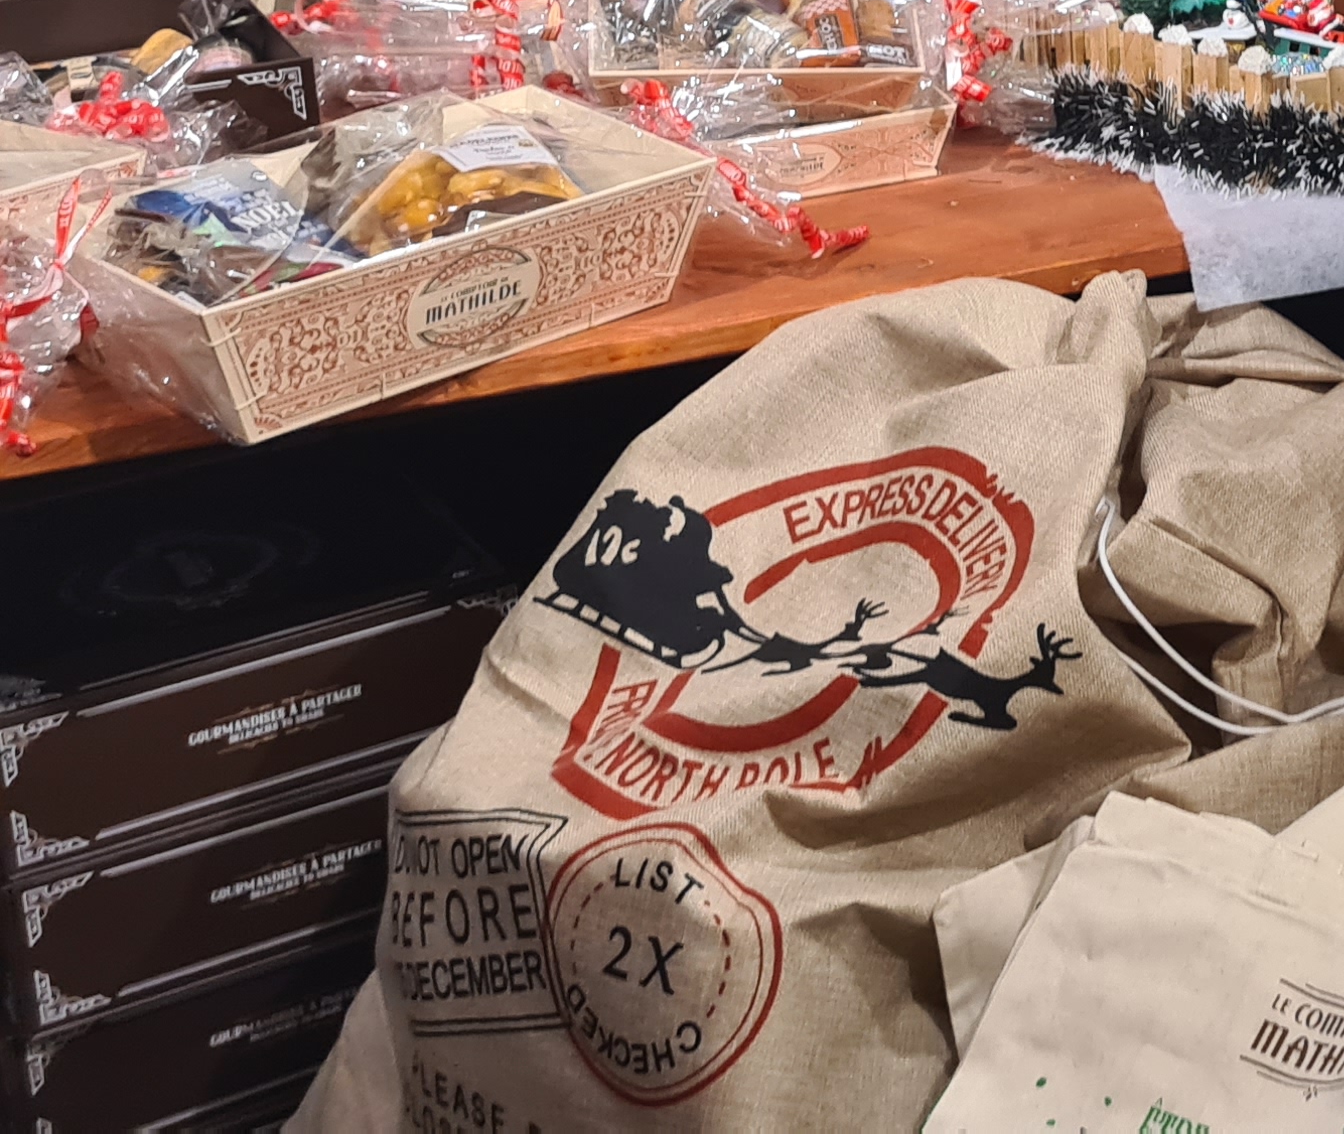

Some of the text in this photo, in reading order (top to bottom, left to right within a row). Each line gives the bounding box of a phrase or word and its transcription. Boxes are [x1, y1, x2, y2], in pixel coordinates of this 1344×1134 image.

[426, 280, 521, 325] MATHILDE
[783, 473, 1008, 601] EXPRESS DELIVERY
[188, 706, 286, 747] GOURMANDISES
[301, 683, 362, 711] PARTAGER
[594, 728, 729, 803] NORTH
[451, 833, 530, 879] OPEN
[613, 856, 705, 905] LIST
[392, 883, 538, 948] BEFORE
[566, 982, 703, 1075] CHECKED
[1271, 993, 1293, 1015] LE
